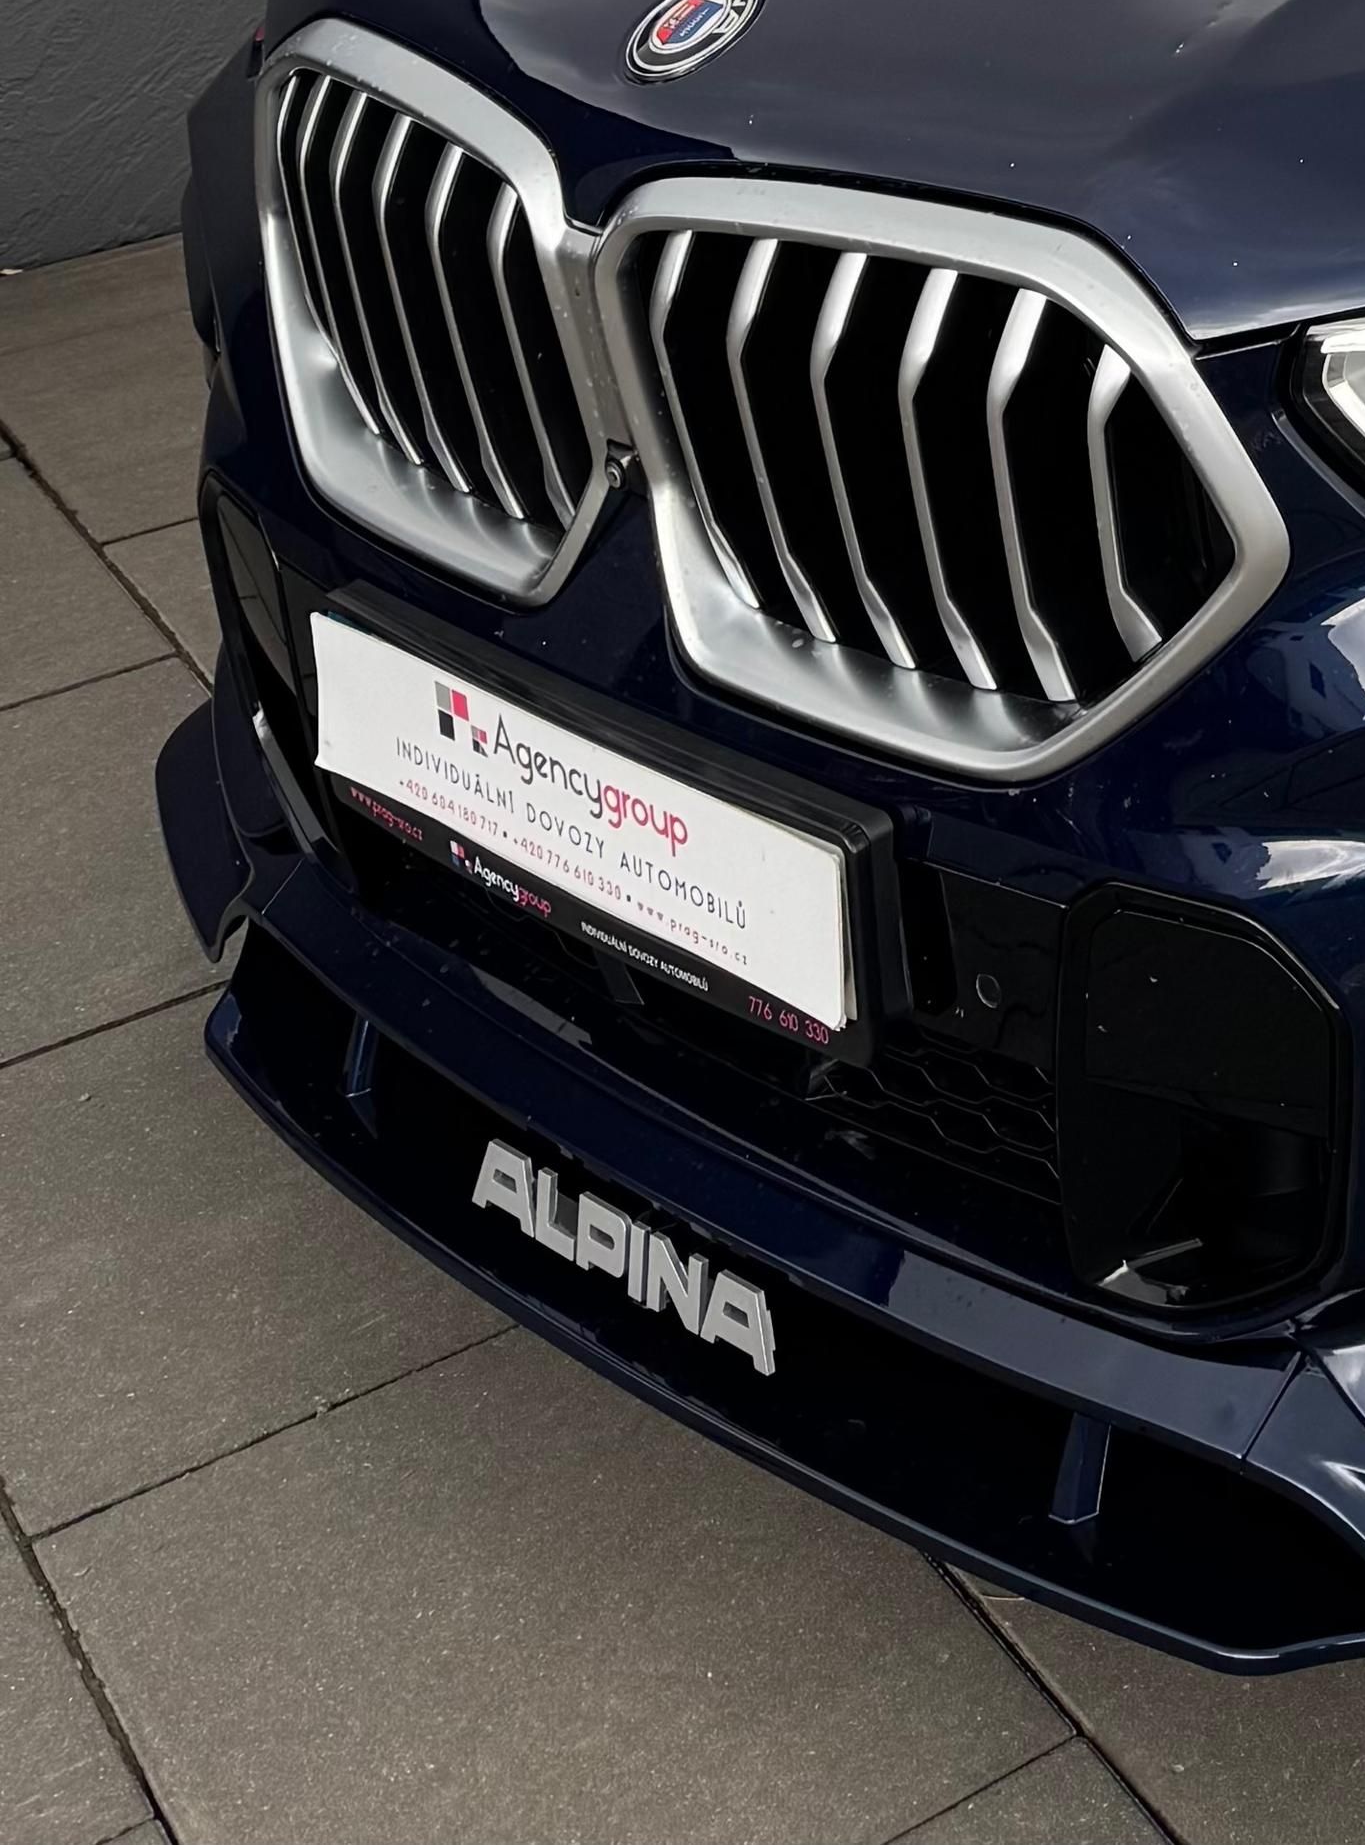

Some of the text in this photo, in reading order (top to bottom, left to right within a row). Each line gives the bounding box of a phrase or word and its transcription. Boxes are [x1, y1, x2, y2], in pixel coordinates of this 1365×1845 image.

[396, 736, 747, 930] INDIVIDUÁLNÍ DOVOZY AUTOMOBILŮ
[493, 712, 688, 857] Agencygroup
[748, 995, 829, 1045] 776 610 330
[471, 1138, 776, 1376] ALPINA
